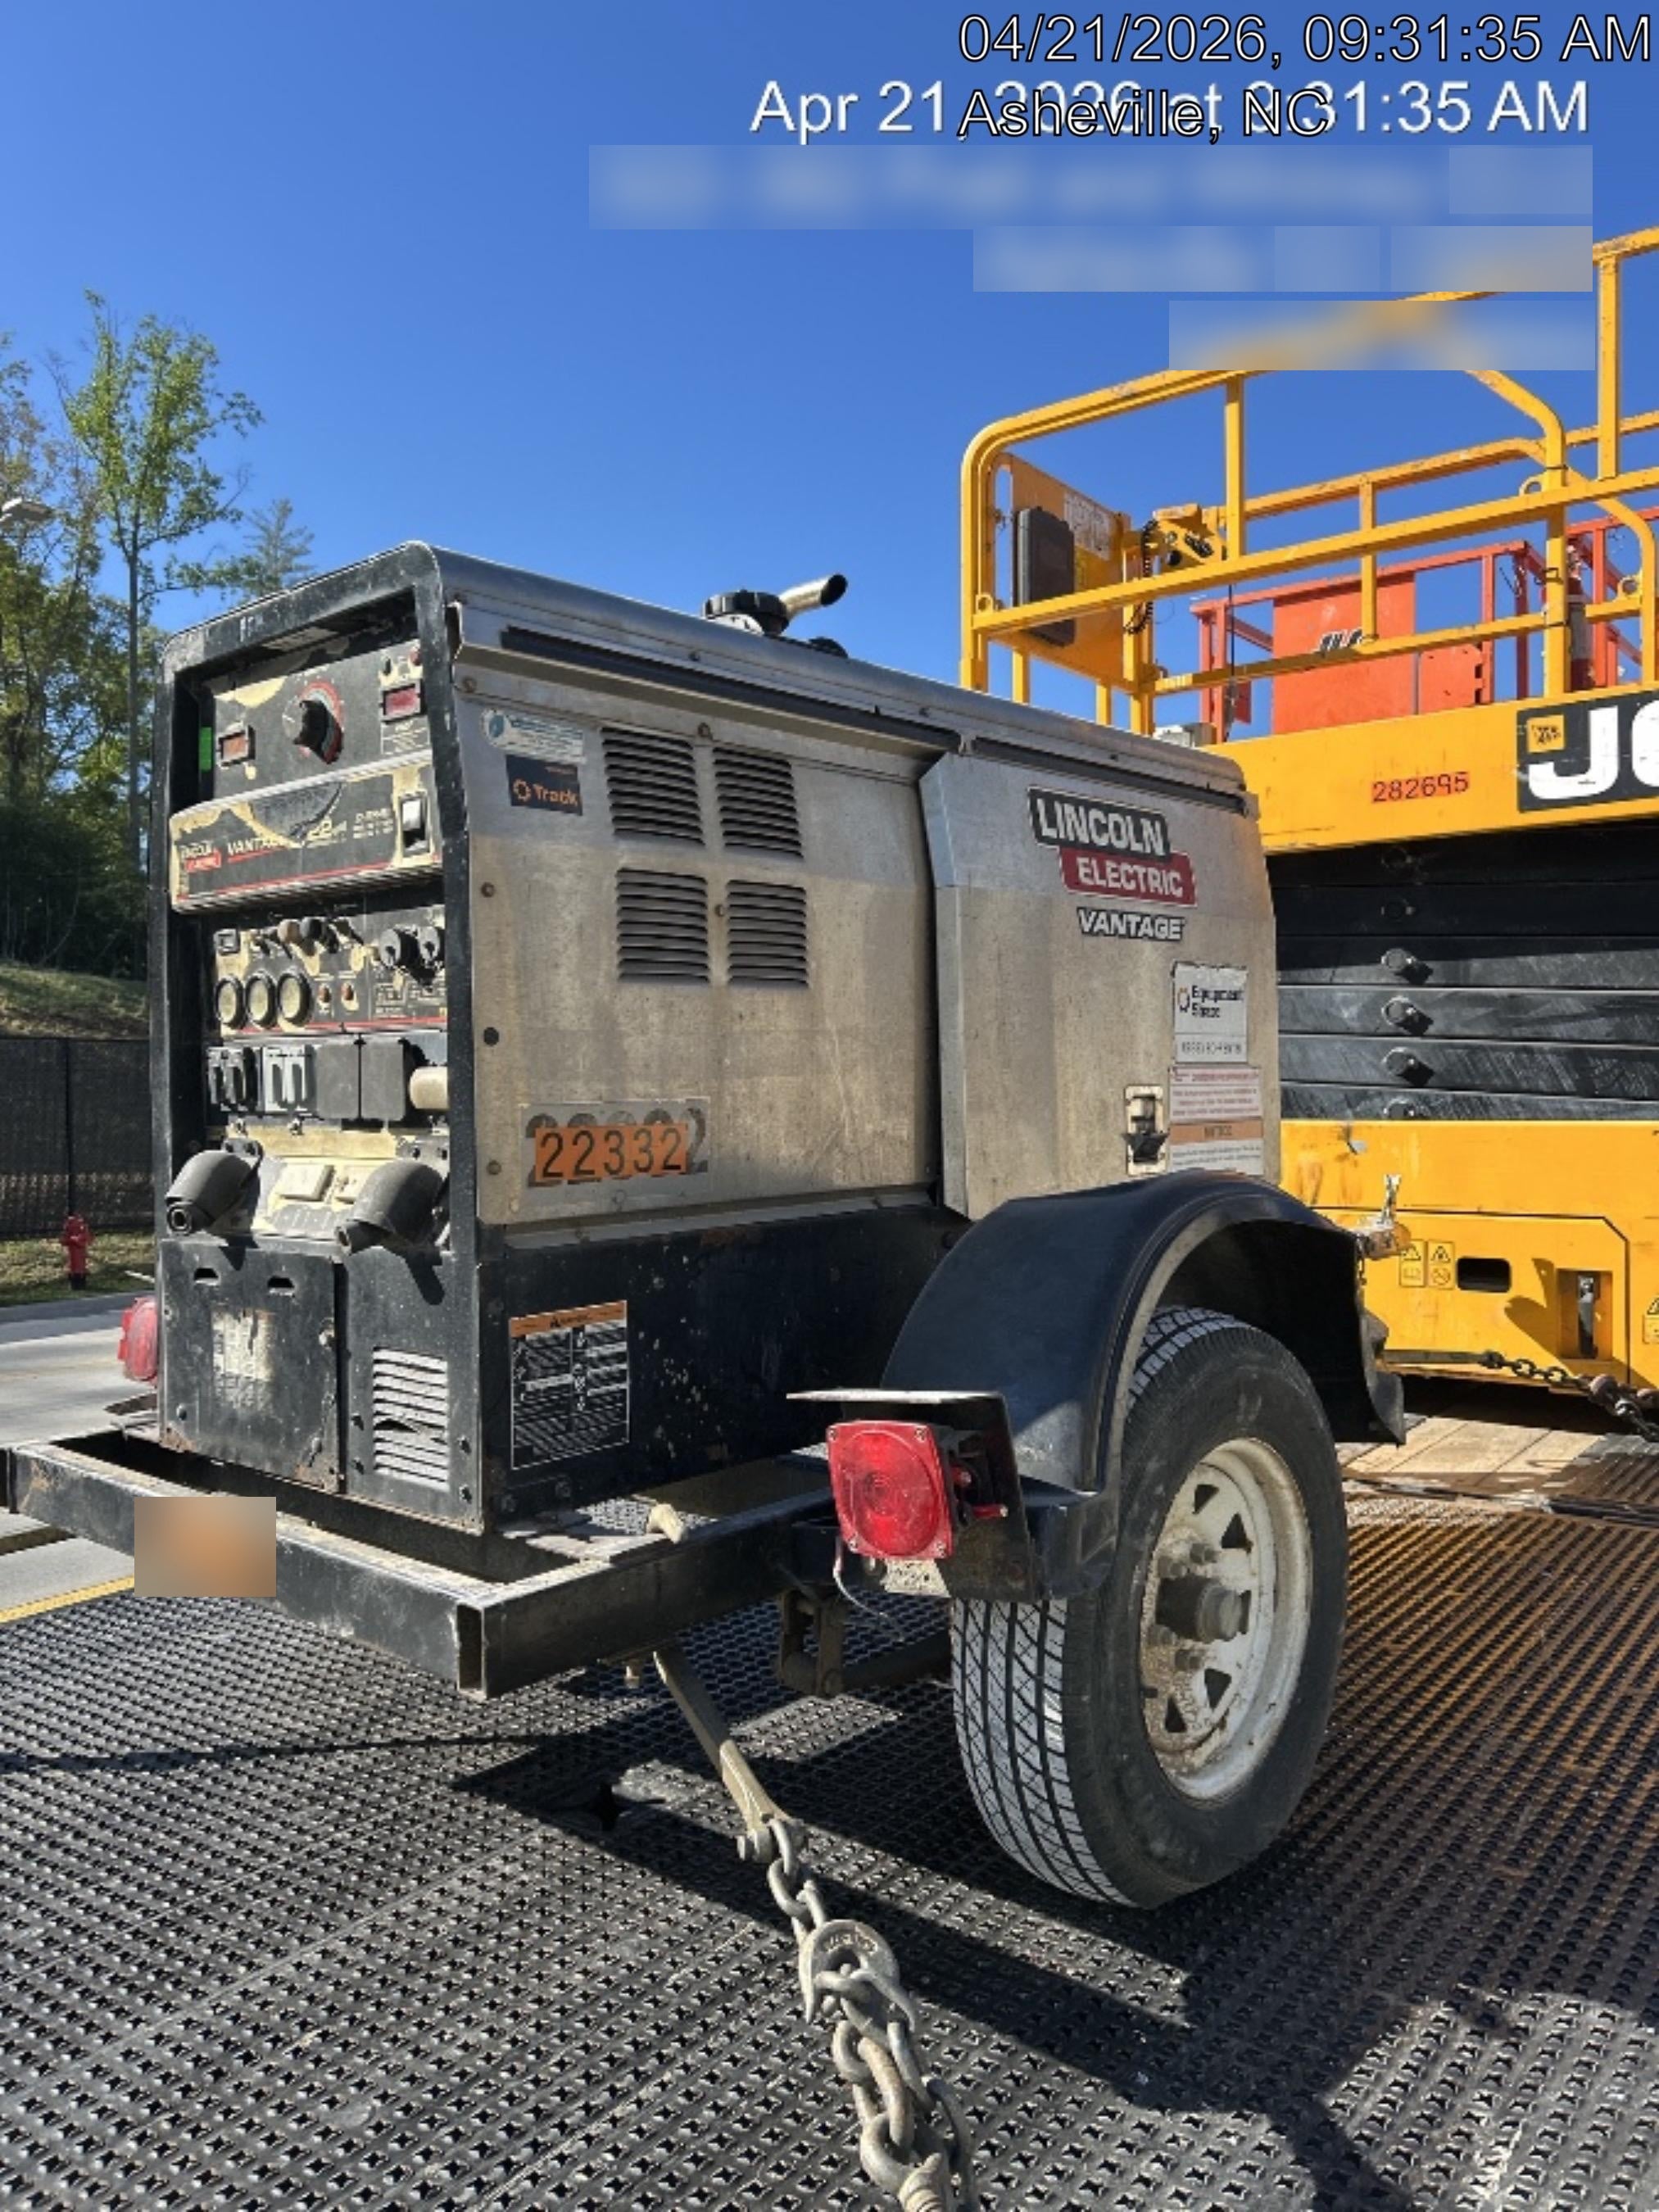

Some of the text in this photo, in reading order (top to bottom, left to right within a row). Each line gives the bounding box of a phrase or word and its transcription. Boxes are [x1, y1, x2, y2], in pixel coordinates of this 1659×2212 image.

[1371, 771, 1470, 803] 282695
[1036, 797, 1167, 857] LINCOLN
[1076, 856, 1184, 898] ELECTRIC
[1077, 909, 1183, 941] VANTAGE
[541, 1127, 682, 1178] 22332
